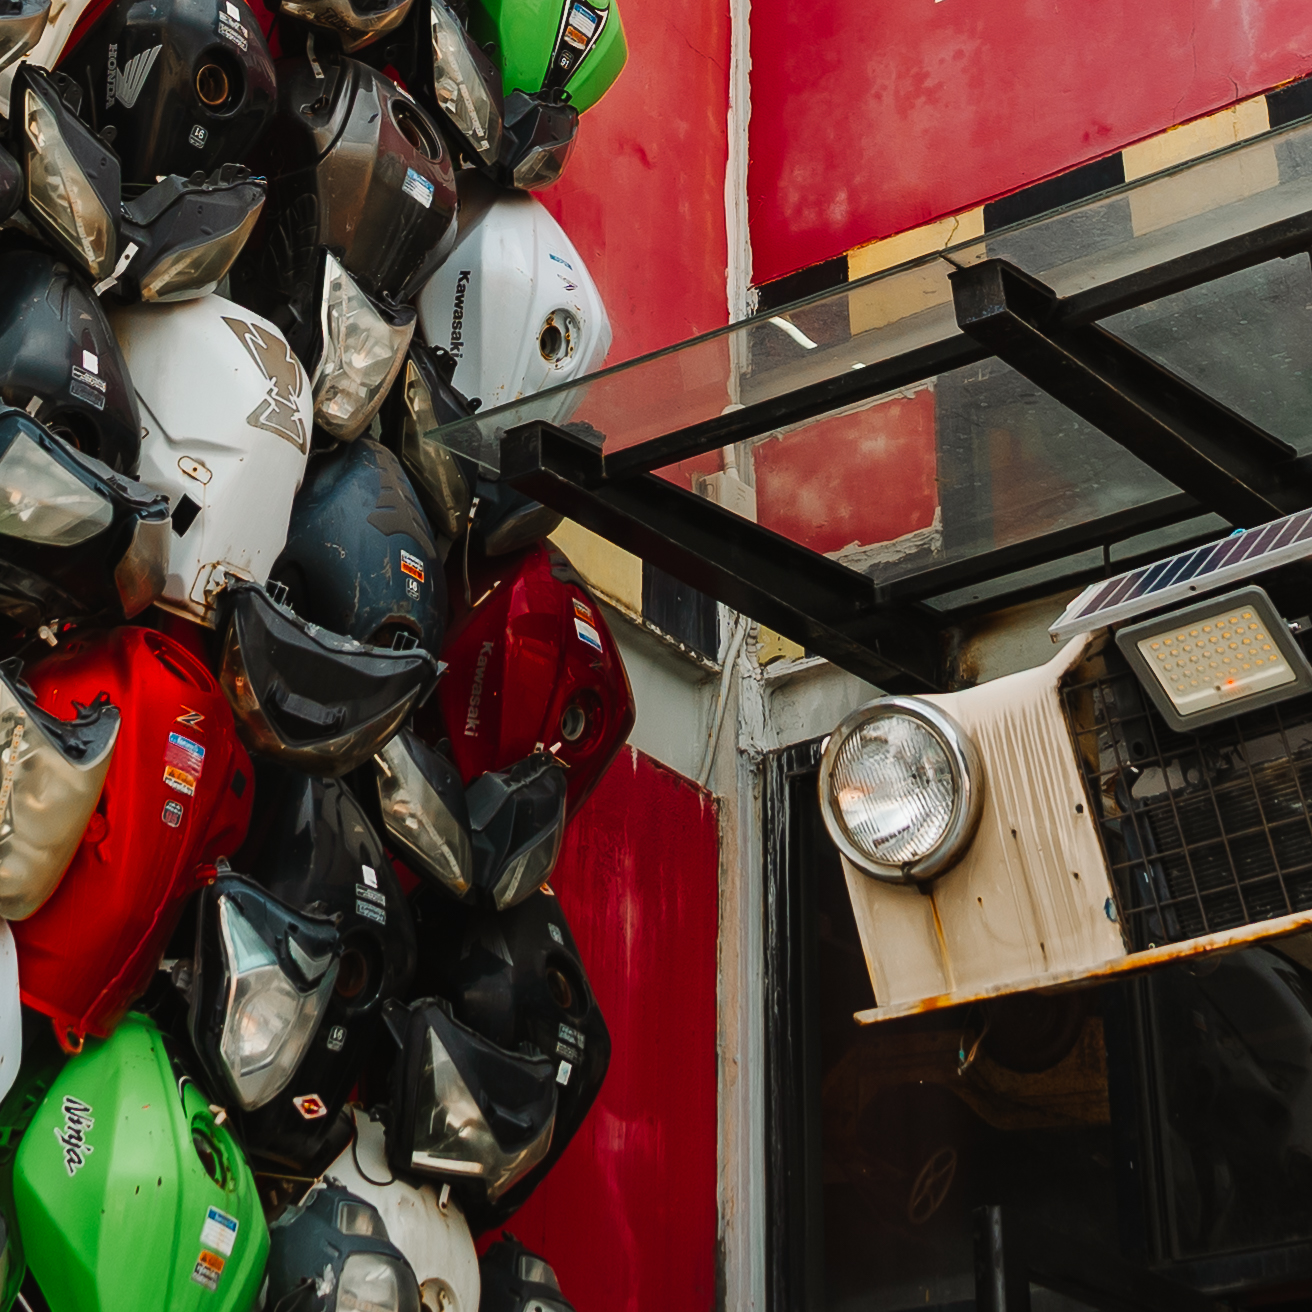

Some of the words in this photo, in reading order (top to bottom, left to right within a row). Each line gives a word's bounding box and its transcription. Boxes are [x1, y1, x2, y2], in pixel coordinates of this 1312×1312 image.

[106, 44, 117, 109] HONDA
[449, 271, 471, 358] Kawasaki
[464, 641, 494, 738] Kawasaki
[53, 1096, 95, 1176] Ninja
